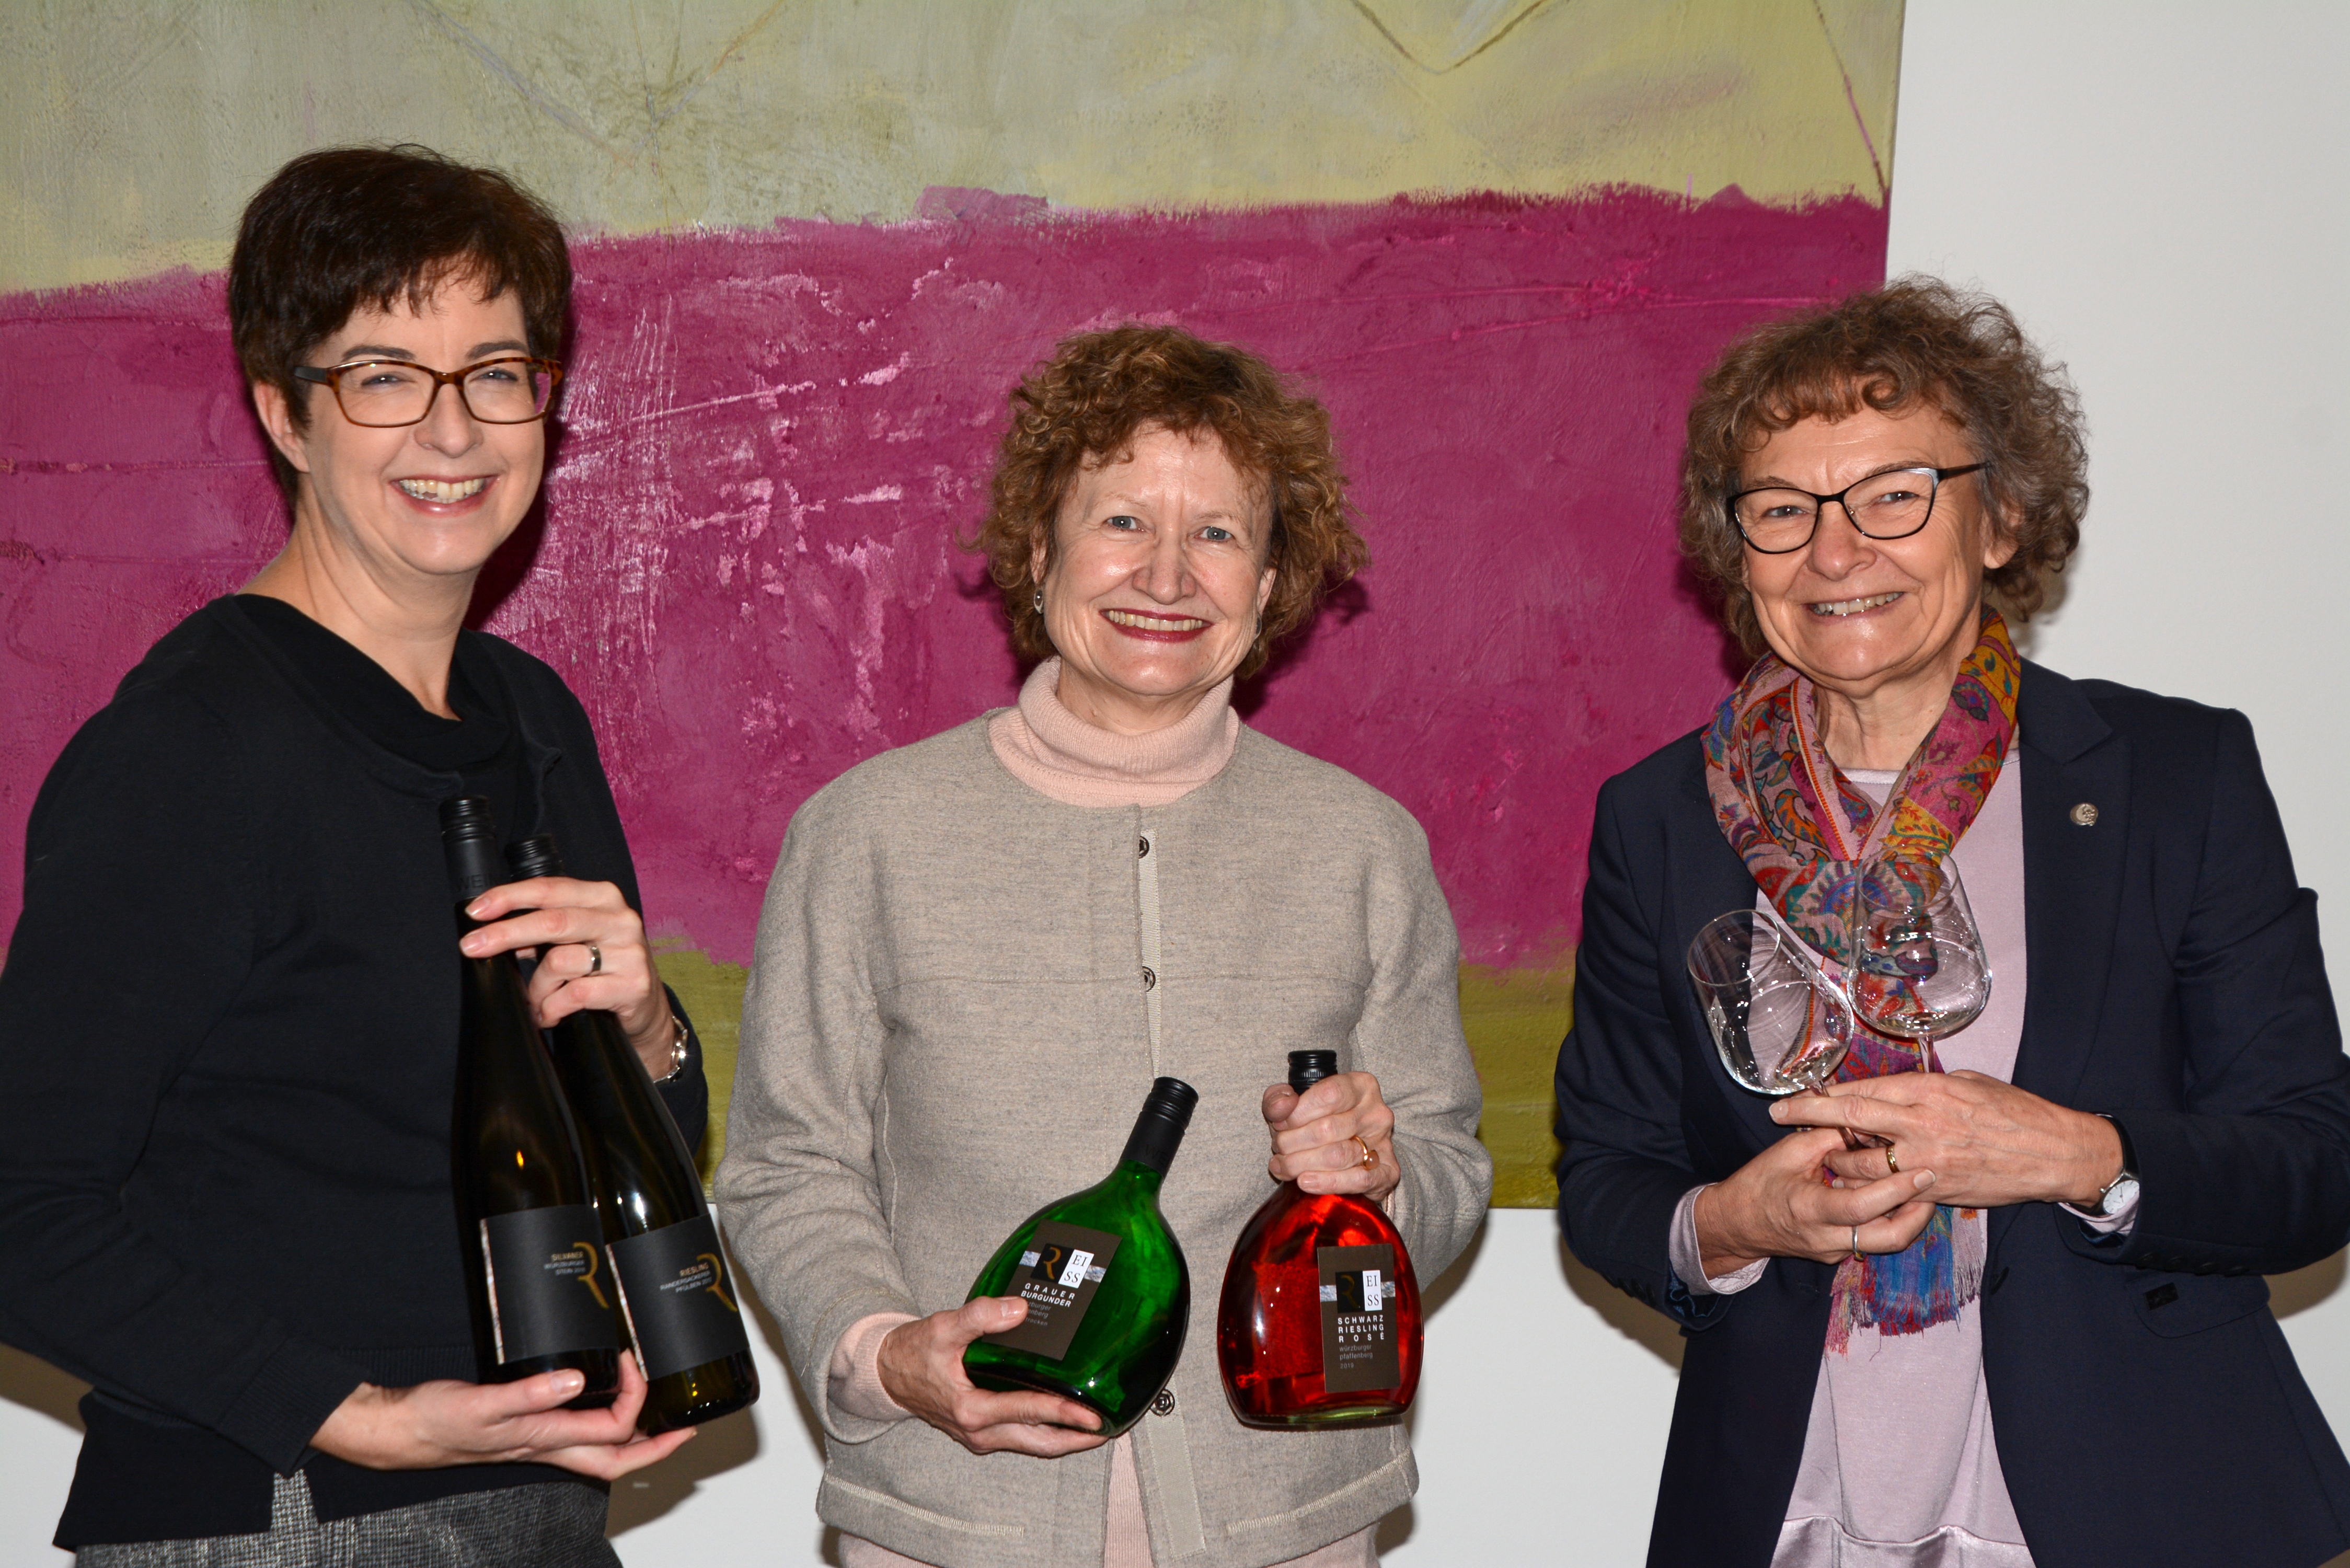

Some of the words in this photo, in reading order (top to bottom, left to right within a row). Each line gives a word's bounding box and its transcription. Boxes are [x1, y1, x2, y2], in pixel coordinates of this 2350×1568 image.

[1025, 1283, 1075, 1299] GRAUER
[1021, 1290, 1072, 1307] BURGUNDER
[1338, 1315, 1384, 1325] SCHWARZ
[1338, 1323, 1384, 1334] RIESLING
[1339, 1344, 1372, 1352] würzburger
[1340, 1352, 1373, 1362] pfaffenberg
